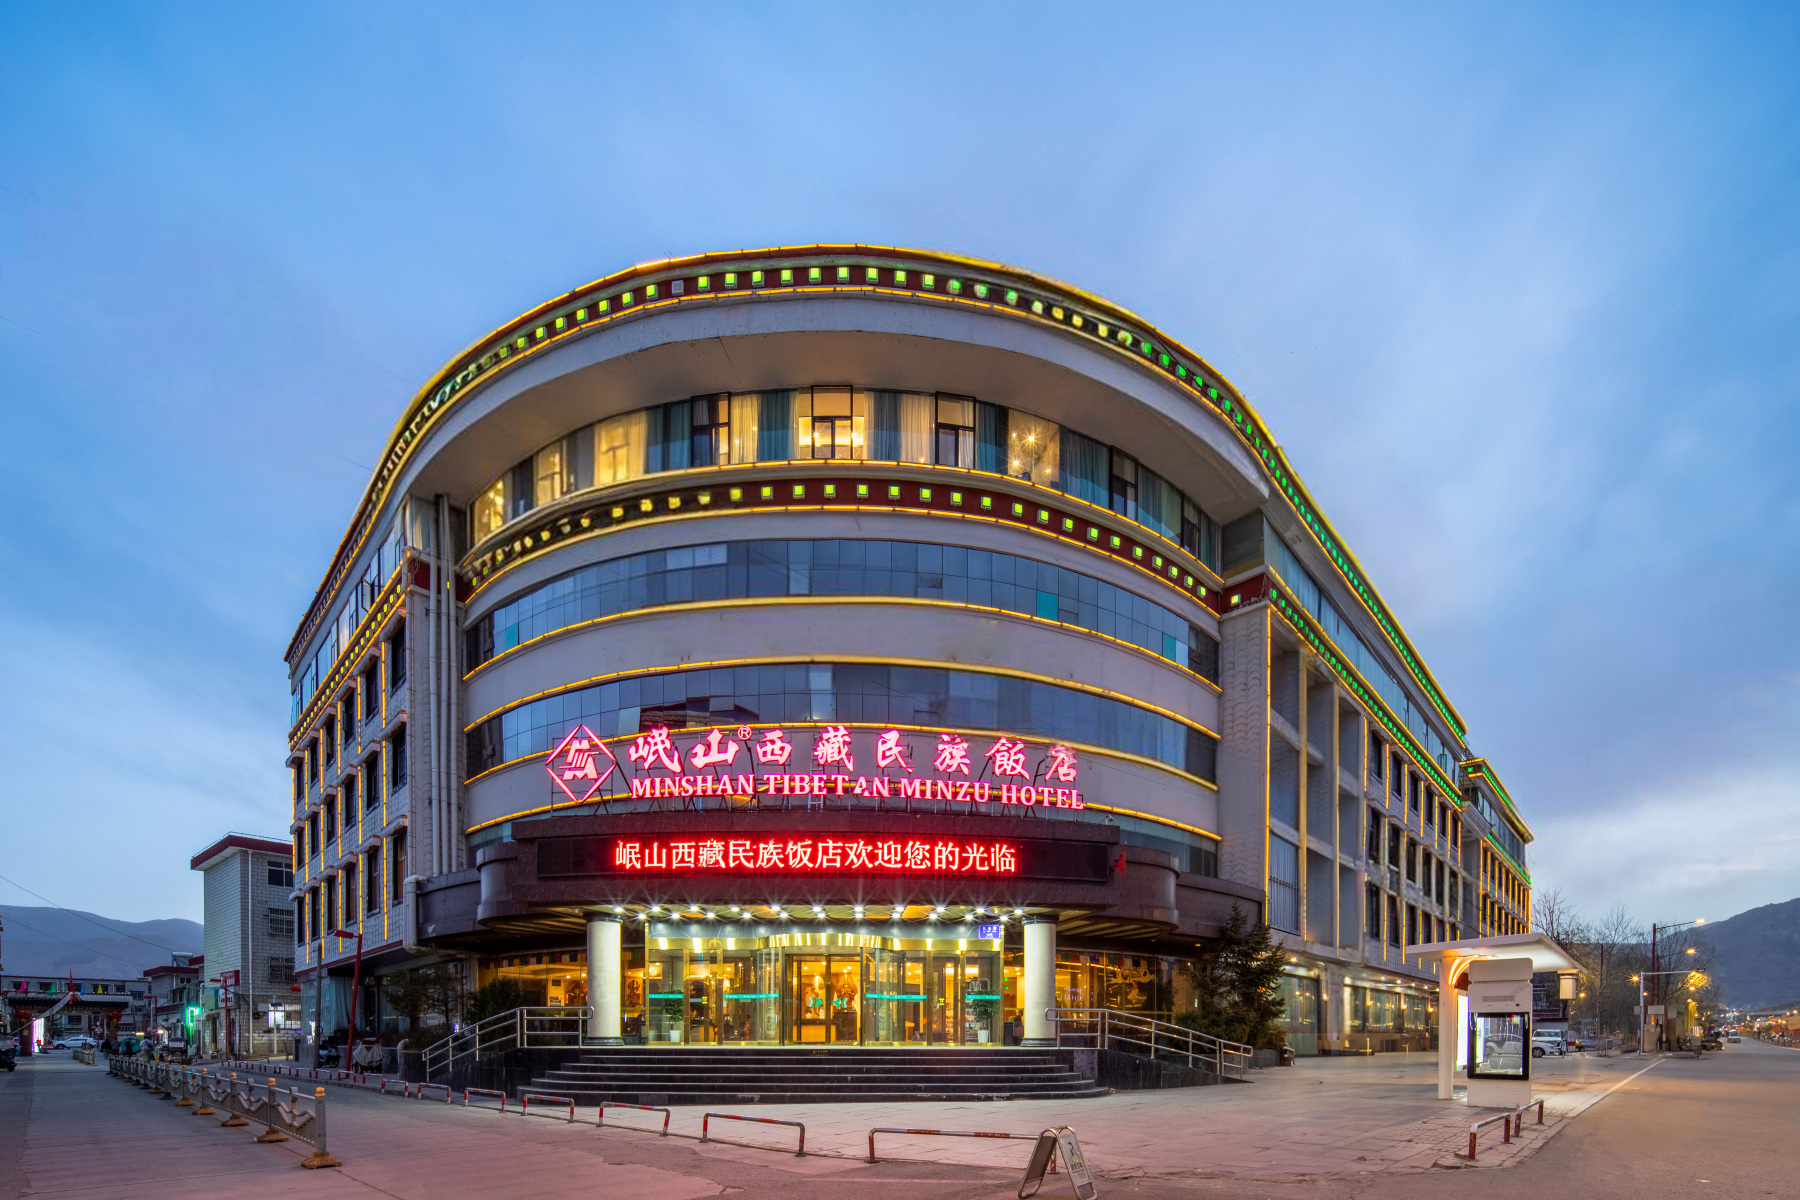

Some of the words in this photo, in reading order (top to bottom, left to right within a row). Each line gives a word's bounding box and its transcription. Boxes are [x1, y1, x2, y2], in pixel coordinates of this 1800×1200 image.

[631, 773, 755, 799] MINSHAN
[762, 773, 891, 798] TIBETAN
[899, 776, 991, 803] MINZU
[1000, 782, 1085, 810] HOTEL
[615, 838, 1016, 872] 岷山西藏民族饭店欢迎您的光临
